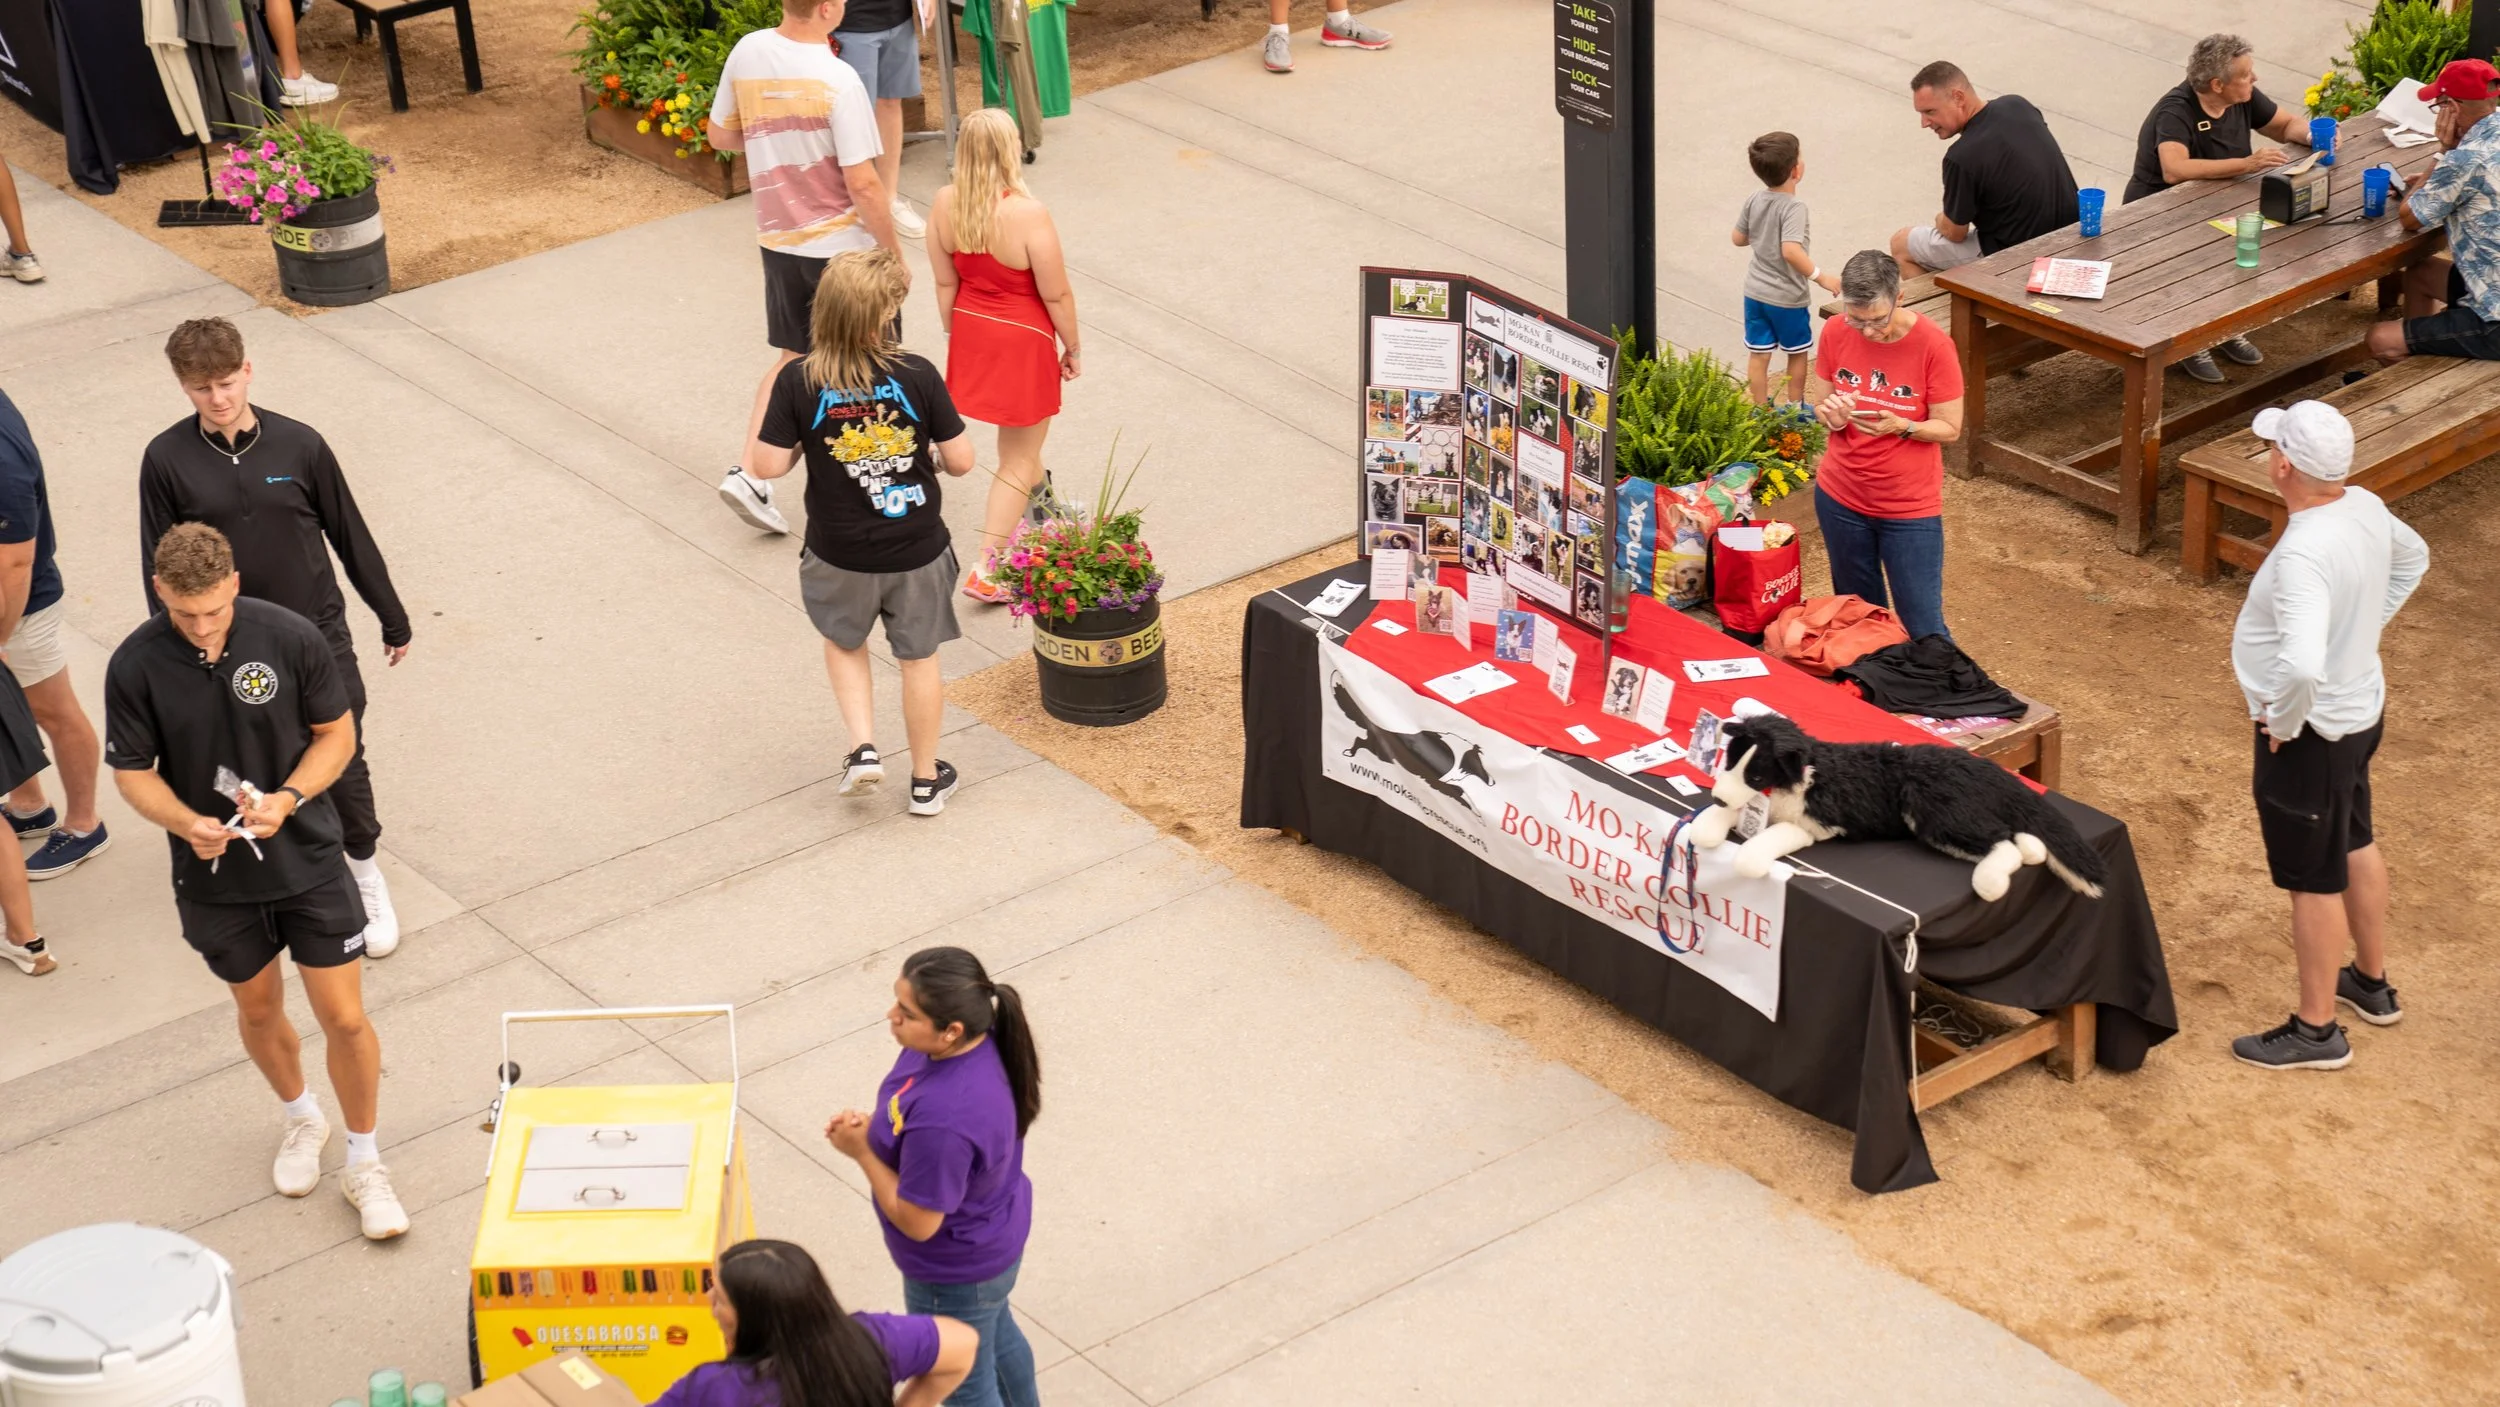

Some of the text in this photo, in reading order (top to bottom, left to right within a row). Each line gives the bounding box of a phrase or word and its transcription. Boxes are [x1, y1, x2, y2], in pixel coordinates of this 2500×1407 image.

[1572, 3, 1597, 22] TAKE
[1570, 18, 1599, 34] YOUR KEYS
[1573, 36, 1597, 55] HIDE
[1560, 47, 1609, 71] YOUR BELONGINGS
[1571, 68, 1598, 87] LOCK
[1570, 83, 1600, 99] YOUR CARS
[1508, 316, 1540, 339] MO-KAN
[1508, 327, 1604, 380] BORDER COLLIE RESCUE
[1763, 565, 1800, 591] BORDER
[1564, 789, 1700, 881] MO-KAN
[1500, 802, 1773, 950] BORDER COLLIE
[1565, 875, 1706, 955] RESCUE
[536, 1324, 661, 1344] QUESABROSA
